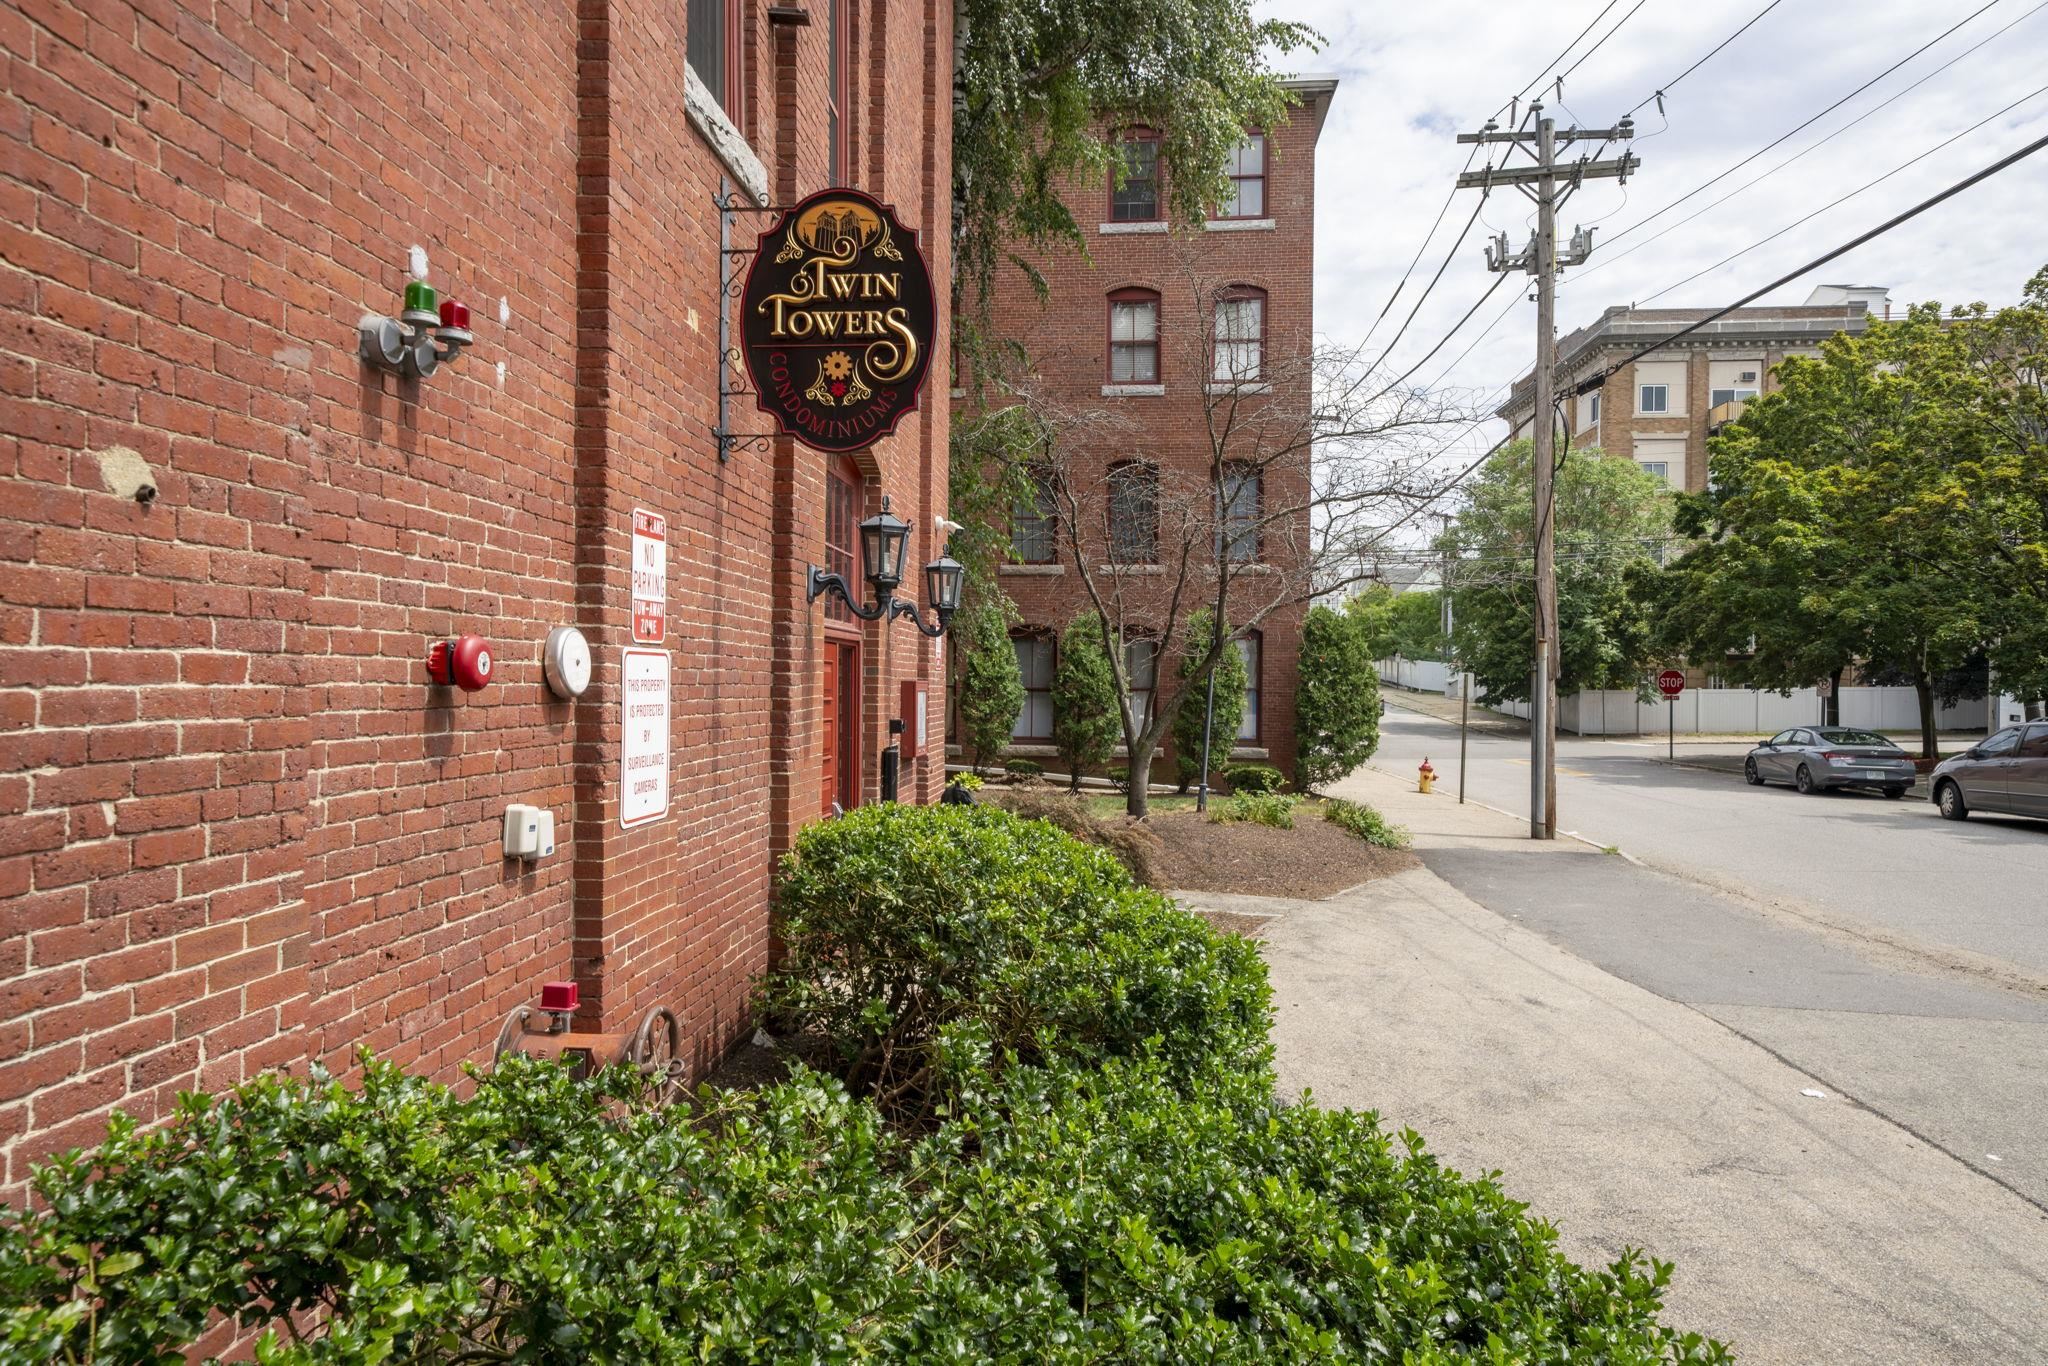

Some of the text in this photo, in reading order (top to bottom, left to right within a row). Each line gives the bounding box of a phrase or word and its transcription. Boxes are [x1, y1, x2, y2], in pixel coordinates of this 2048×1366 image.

[800, 236, 901, 299] TWIN
[758, 272, 917, 381] TOWERS
[769, 351, 898, 438] CONDOMINIUMS
[644, 543, 655, 568] NO
[634, 571, 665, 598] PARKING
[634, 600, 664, 618] TOW-AWAY
[640, 618, 657, 634] ZONE
[628, 679, 665, 692] THIS PROPERTY
[1660, 677, 1683, 687] STOP
[629, 703, 664, 719] IS PROTECTED
[643, 729, 651, 743] BY
[628, 752, 665, 770] SURVEILLANCE
[634, 778, 658, 795] CAMERAS
